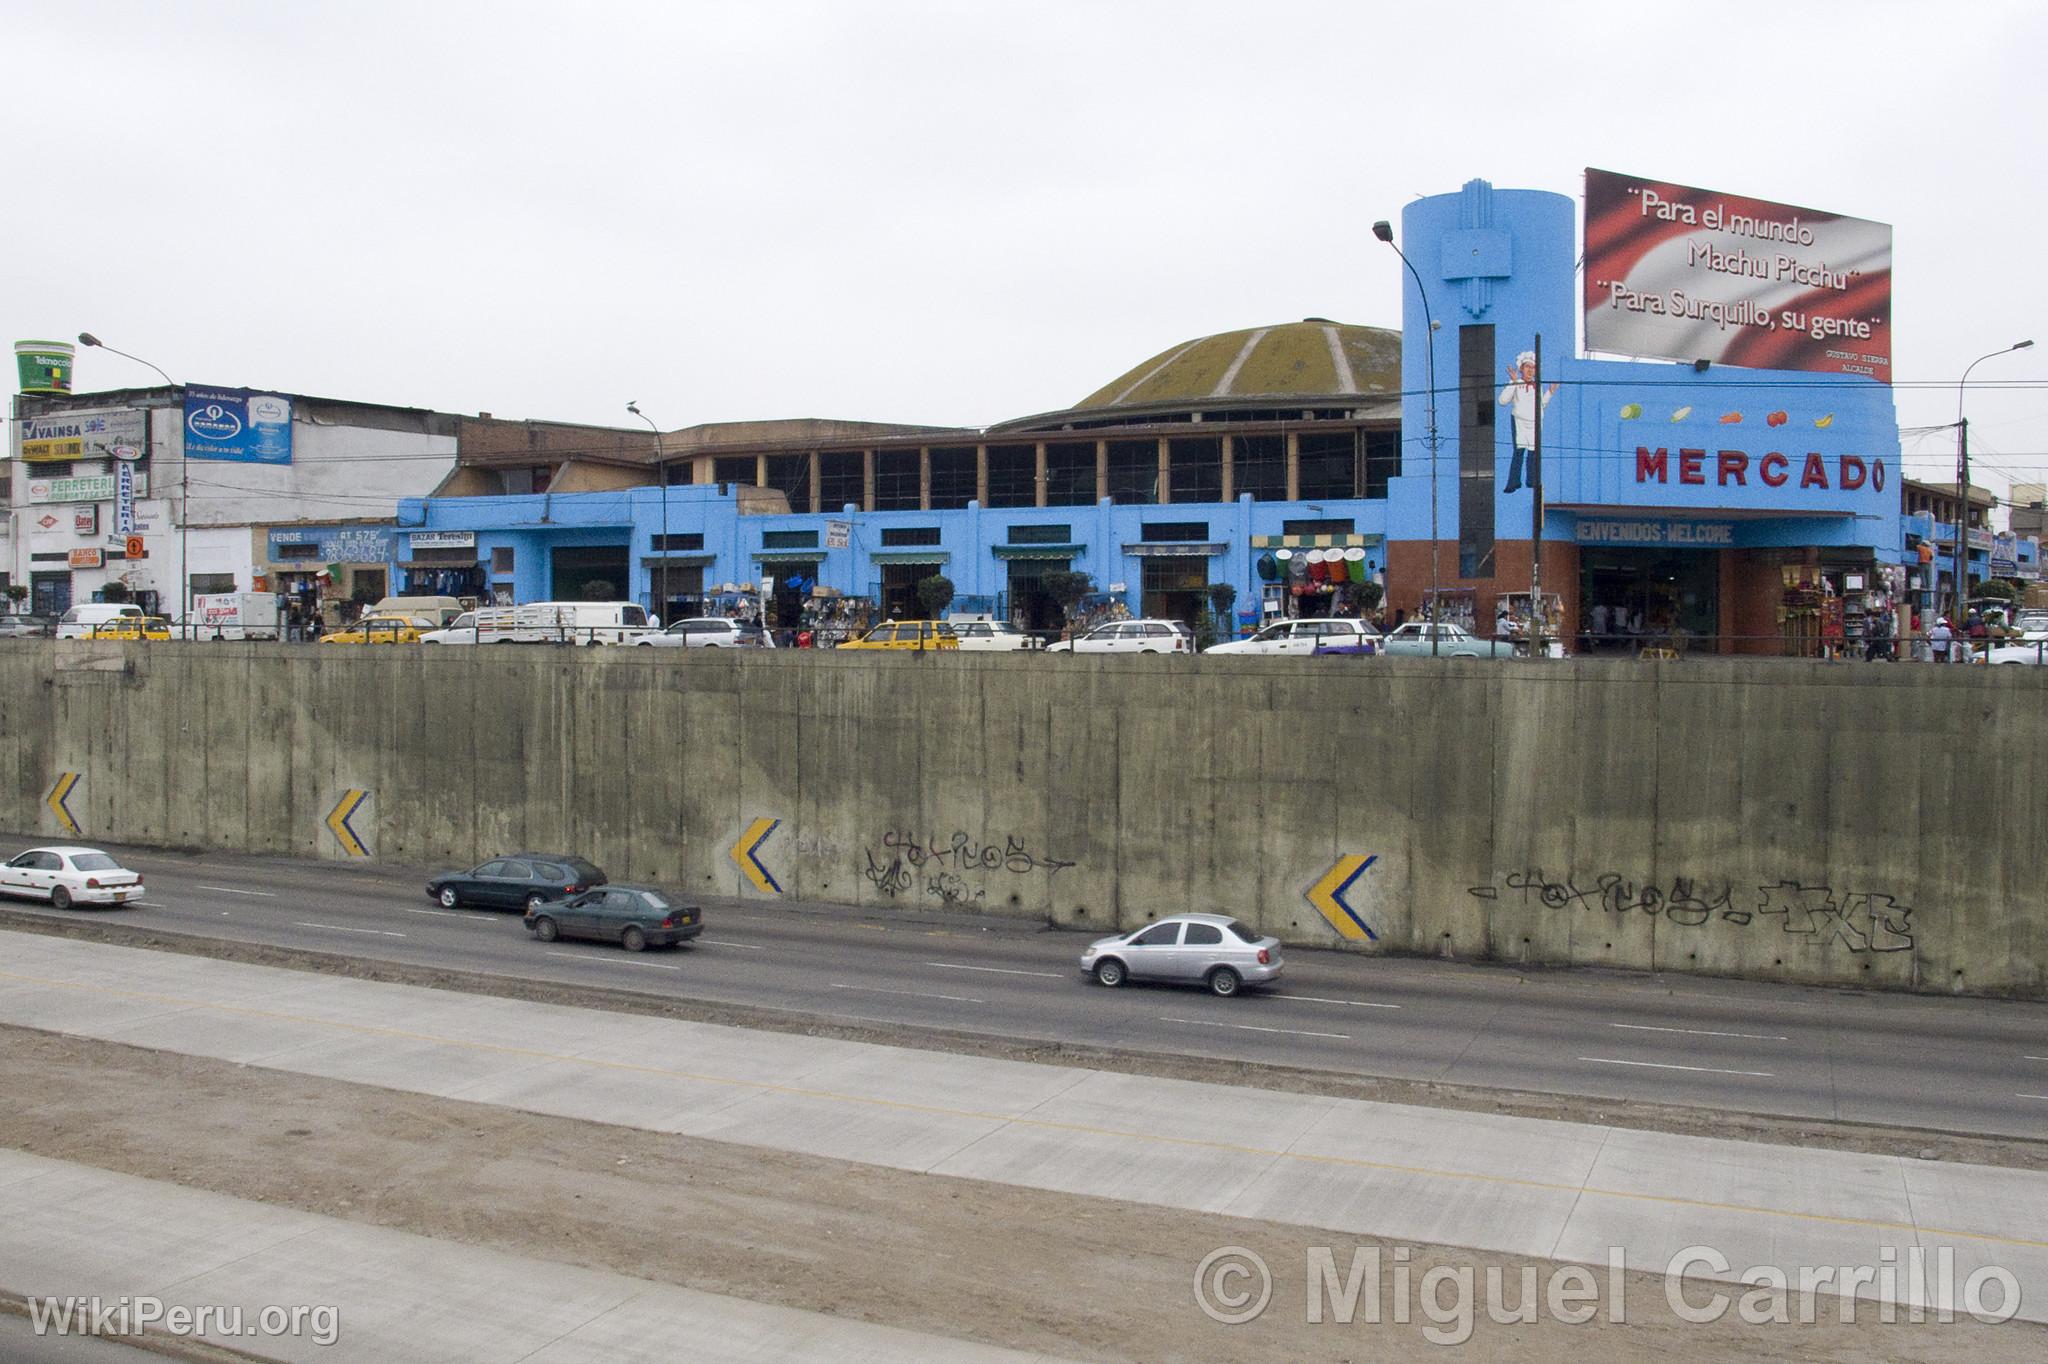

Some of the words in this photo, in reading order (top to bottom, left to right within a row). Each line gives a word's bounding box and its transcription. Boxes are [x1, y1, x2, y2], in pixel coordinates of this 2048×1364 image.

[1702, 204, 1723, 231] el
[1730, 217, 1814, 246] mundo
[1687, 238, 1768, 278] Machu
[1670, 289, 1776, 330] Surquillo,
[1781, 301, 1805, 331] su
[38, 424, 81, 439] VAINSA
[1636, 447, 1886, 493] MERCADO
[270, 532, 303, 542] VENDE
[1667, 523, 1734, 544] WELCOME
